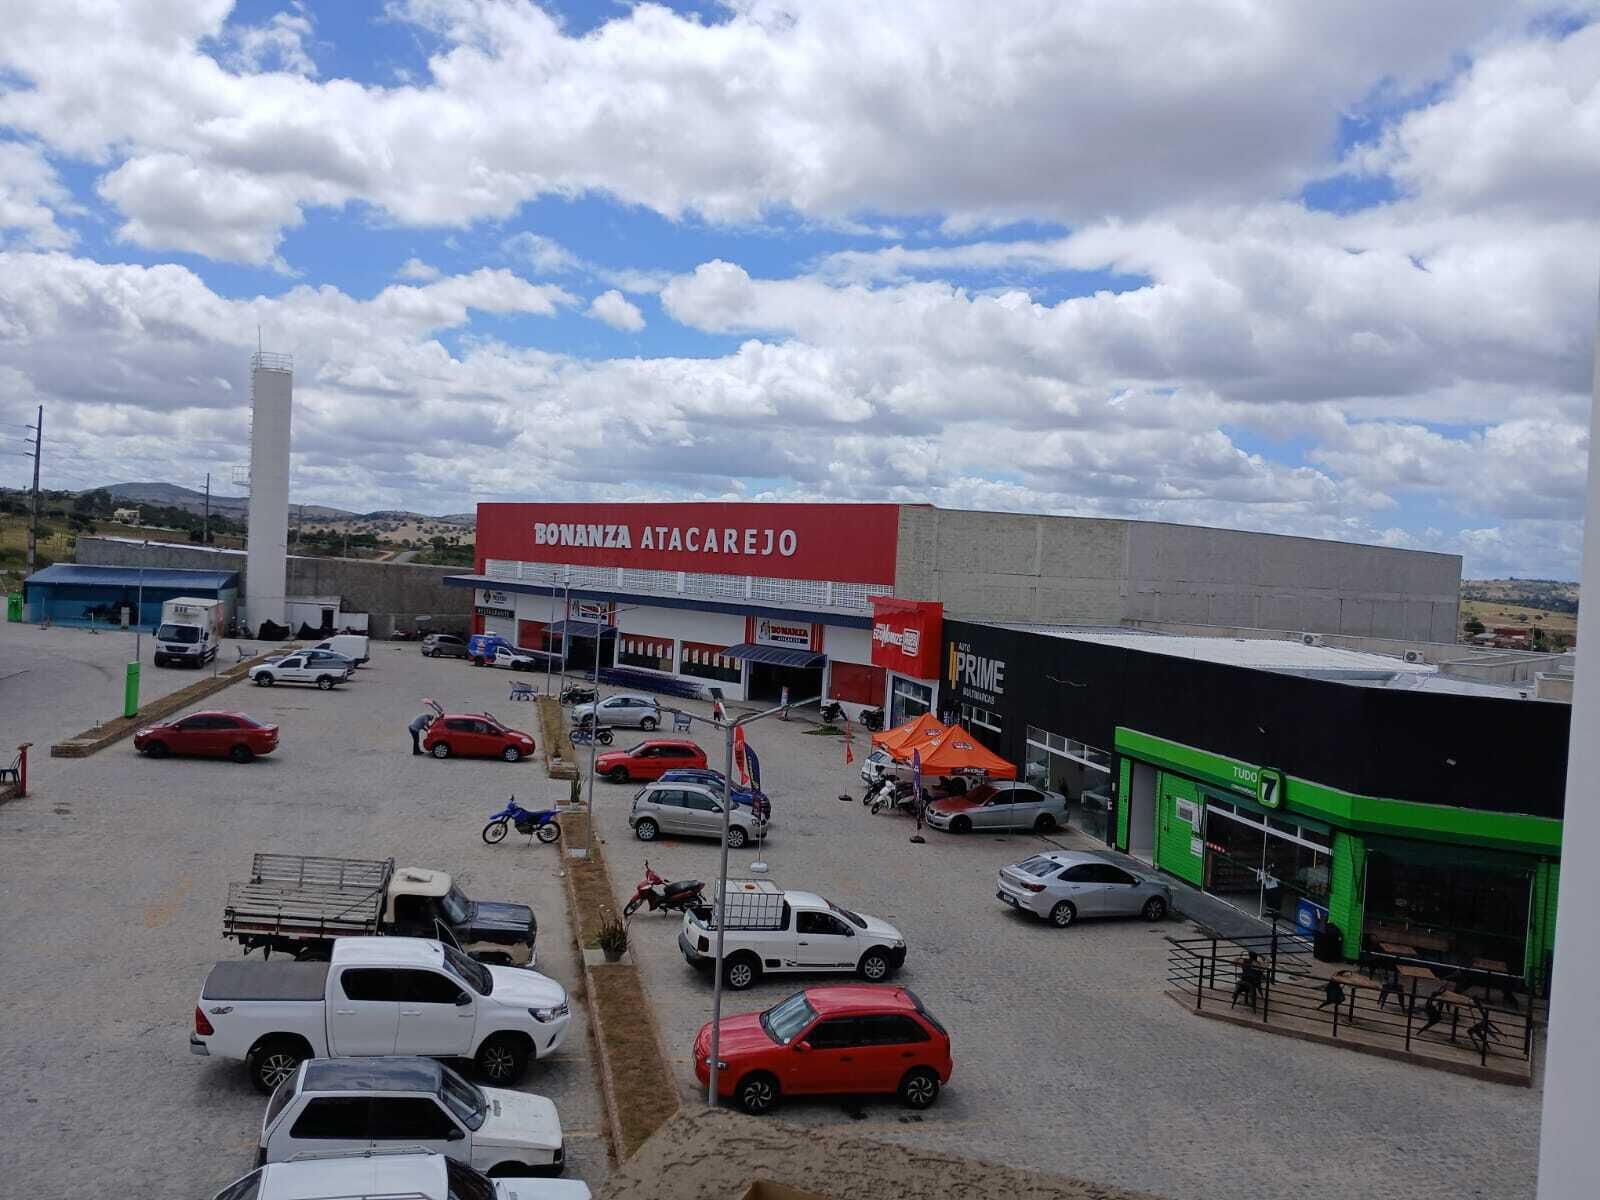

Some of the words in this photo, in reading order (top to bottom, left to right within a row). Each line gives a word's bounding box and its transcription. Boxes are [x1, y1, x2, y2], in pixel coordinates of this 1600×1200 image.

[534, 523, 632, 548] BONANZA
[640, 526, 797, 556] ATACAREJO
[956, 652, 1006, 694] PRIME
[1233, 766, 1258, 783] TUDO
[1262, 776, 1277, 801] 7
